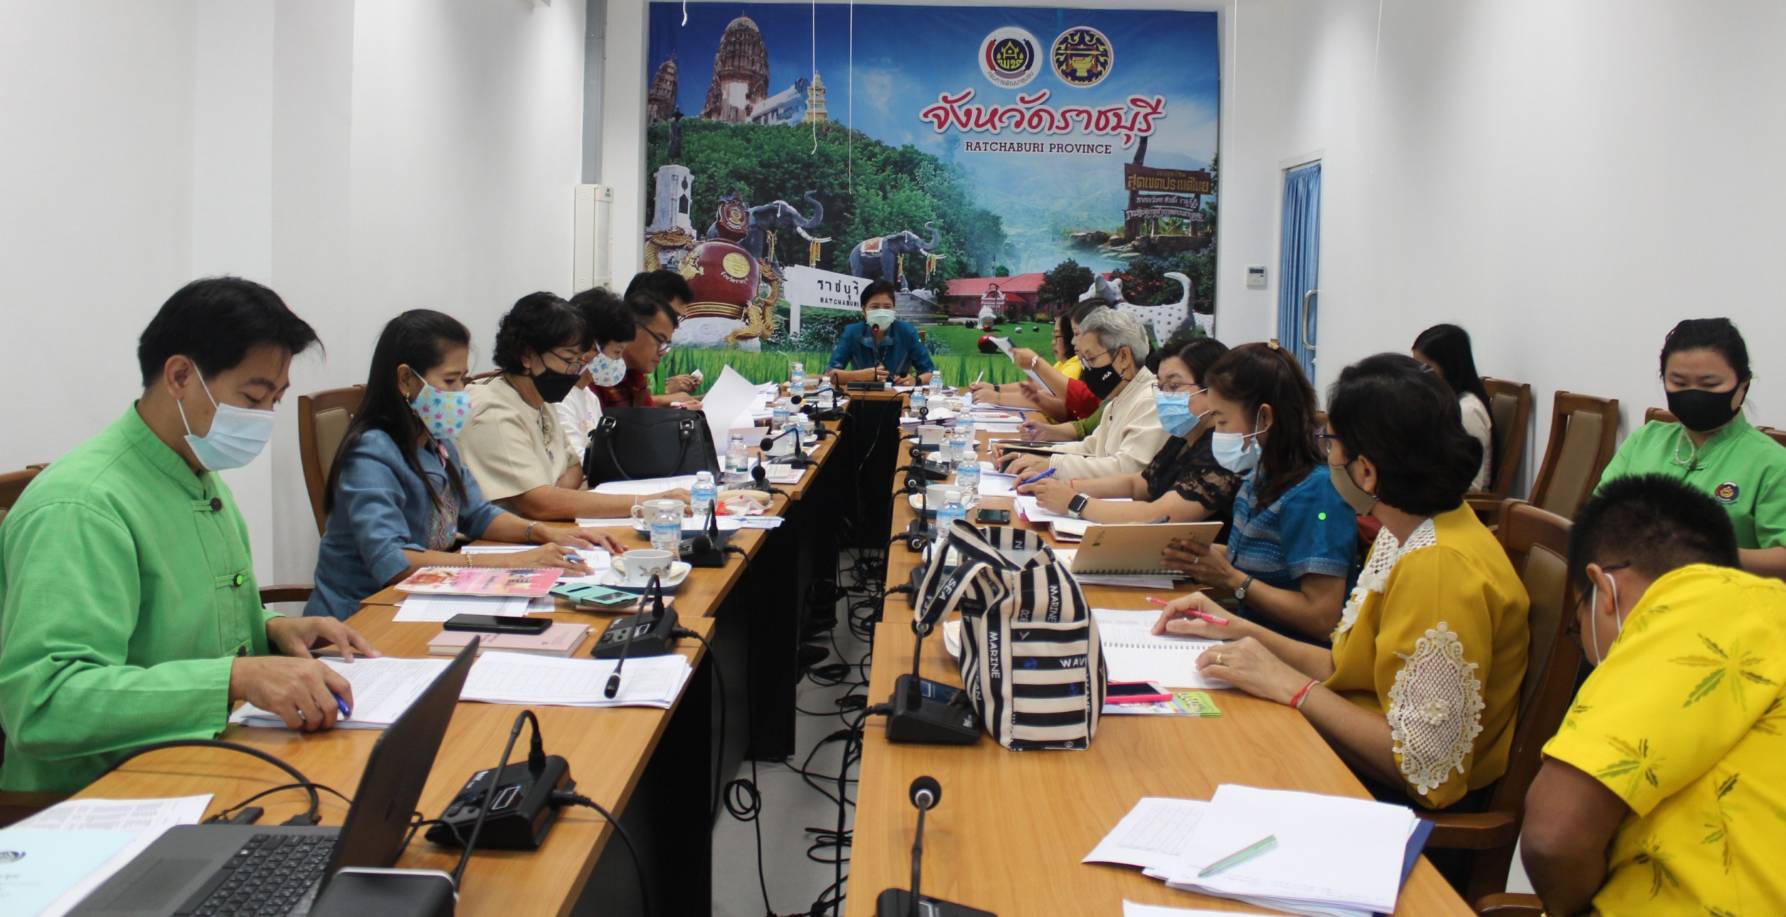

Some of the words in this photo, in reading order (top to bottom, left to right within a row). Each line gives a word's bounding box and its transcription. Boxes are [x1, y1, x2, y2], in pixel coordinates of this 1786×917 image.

[920, 89, 1164, 146] จังหวัดราชบุรี
[965, 141, 1044, 153] RATCHABURI
[1049, 143, 1112, 154] PROVINCE
[817, 280, 859, 300] ราชบุรี
[939, 578, 956, 600] SEA
[1048, 585, 1059, 622] MARINE
[989, 631, 1001, 678] MARINE
